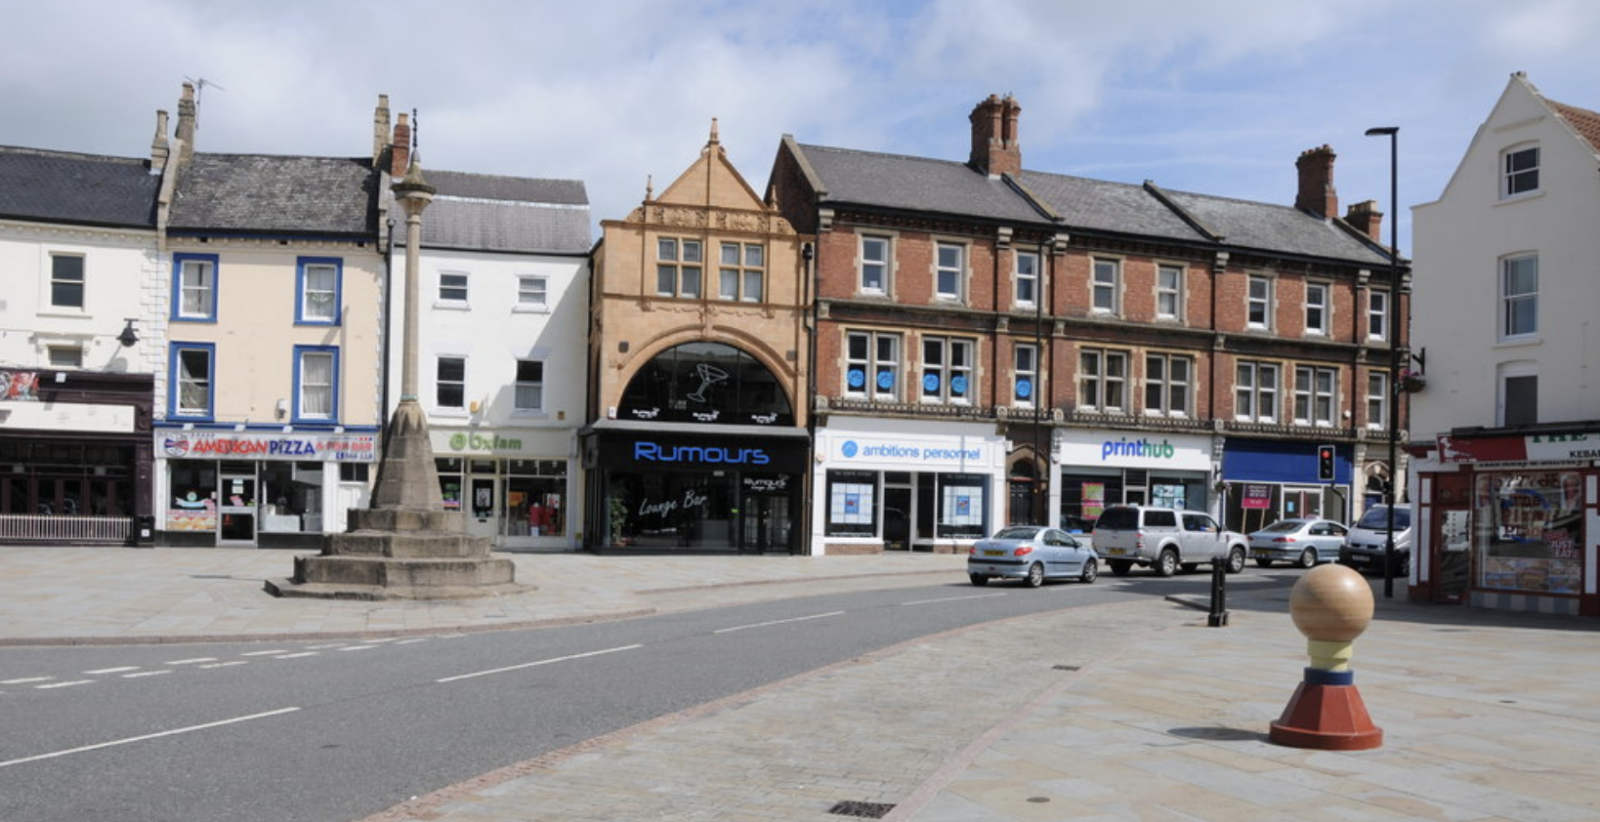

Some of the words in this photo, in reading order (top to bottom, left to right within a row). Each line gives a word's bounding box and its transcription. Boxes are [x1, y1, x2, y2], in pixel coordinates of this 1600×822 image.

[193, 438, 268, 454] AMERICAN
[351, 441, 372, 452] BAR
[469, 434, 522, 451] Oxfam
[1102, 436, 1175, 461] printhub
[634, 441, 770, 464] Rumours
[863, 443, 920, 458] ambitions
[923, 447, 980, 461] personnel
[638, 497, 678, 518] Lounge
[683, 489, 708, 509] Bar
[1551, 539, 1574, 549] JUST
